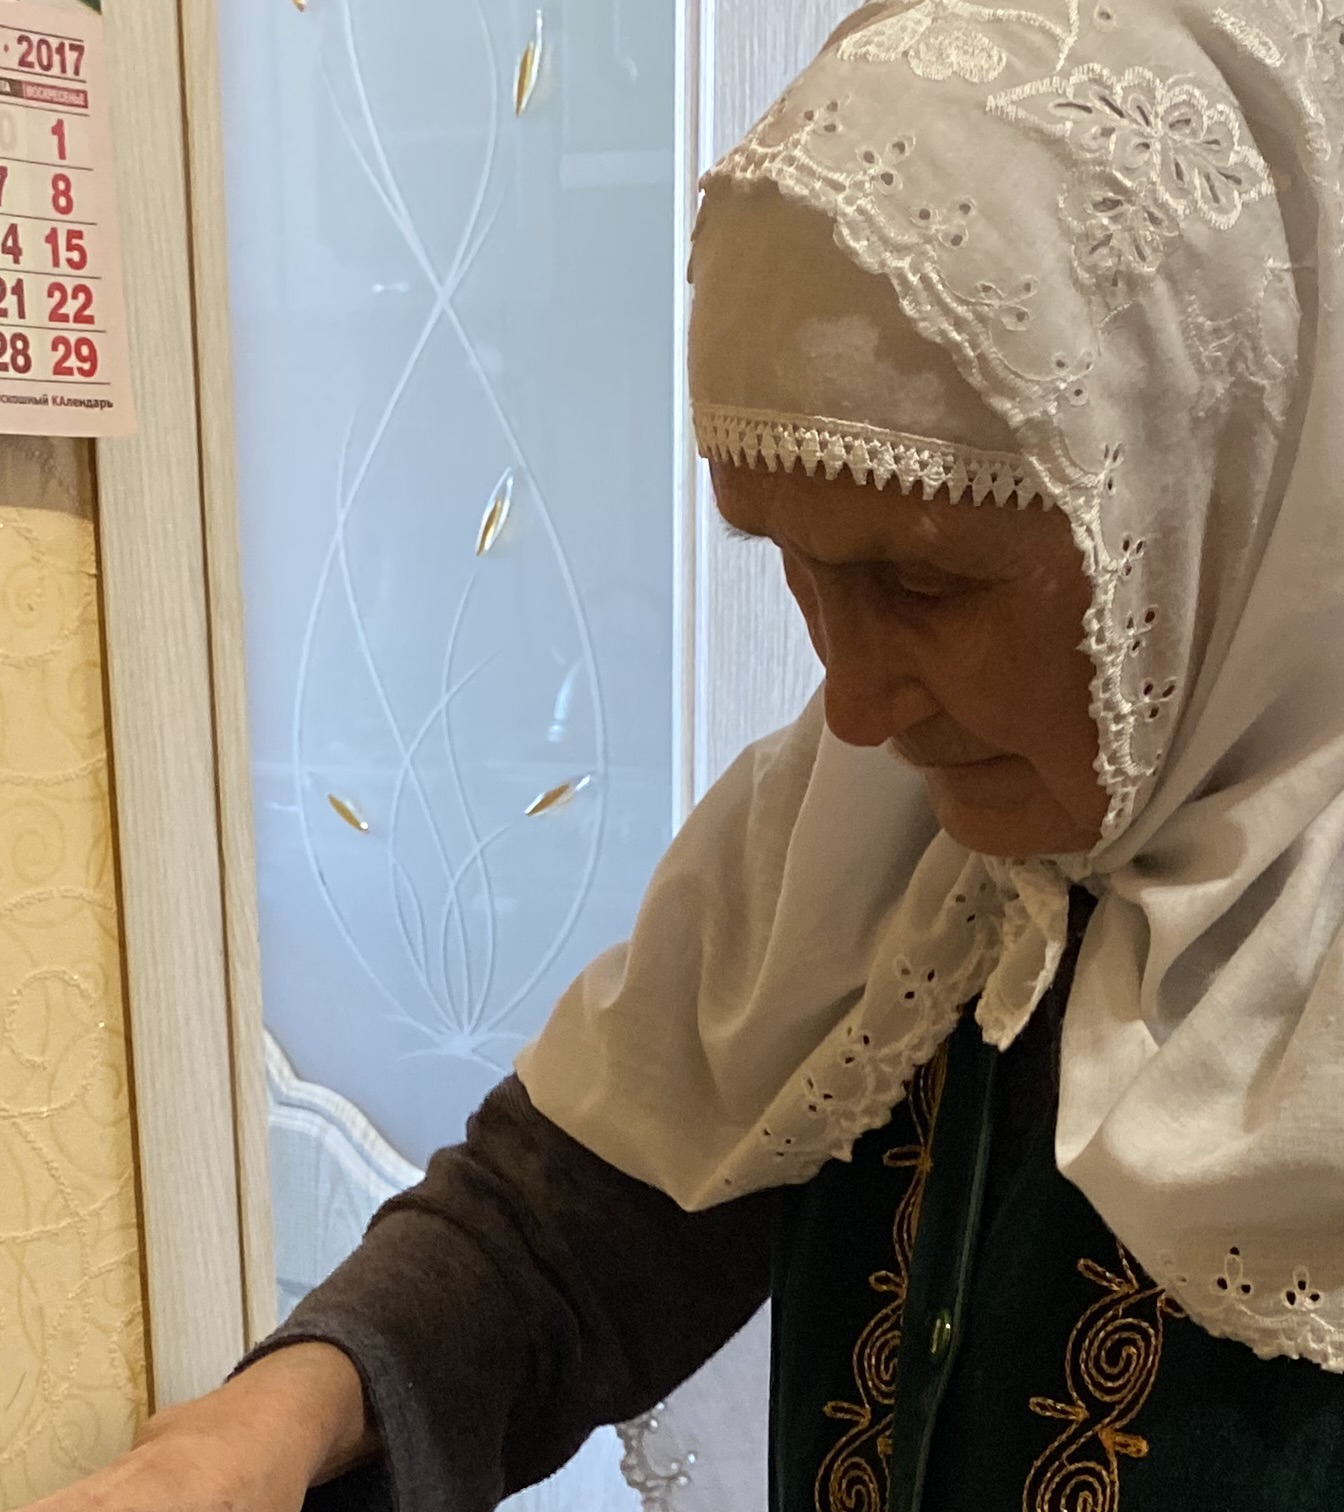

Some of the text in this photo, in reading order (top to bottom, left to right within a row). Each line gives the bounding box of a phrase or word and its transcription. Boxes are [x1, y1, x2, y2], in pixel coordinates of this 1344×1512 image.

[16, 34, 85, 77] 2017
[50, 118, 67, 161] 1
[51, 173, 74, 215] 8
[44, 226, 88, 271] 15
[46, 282, 96, 325] 22
[50, 335, 99, 378] 29
